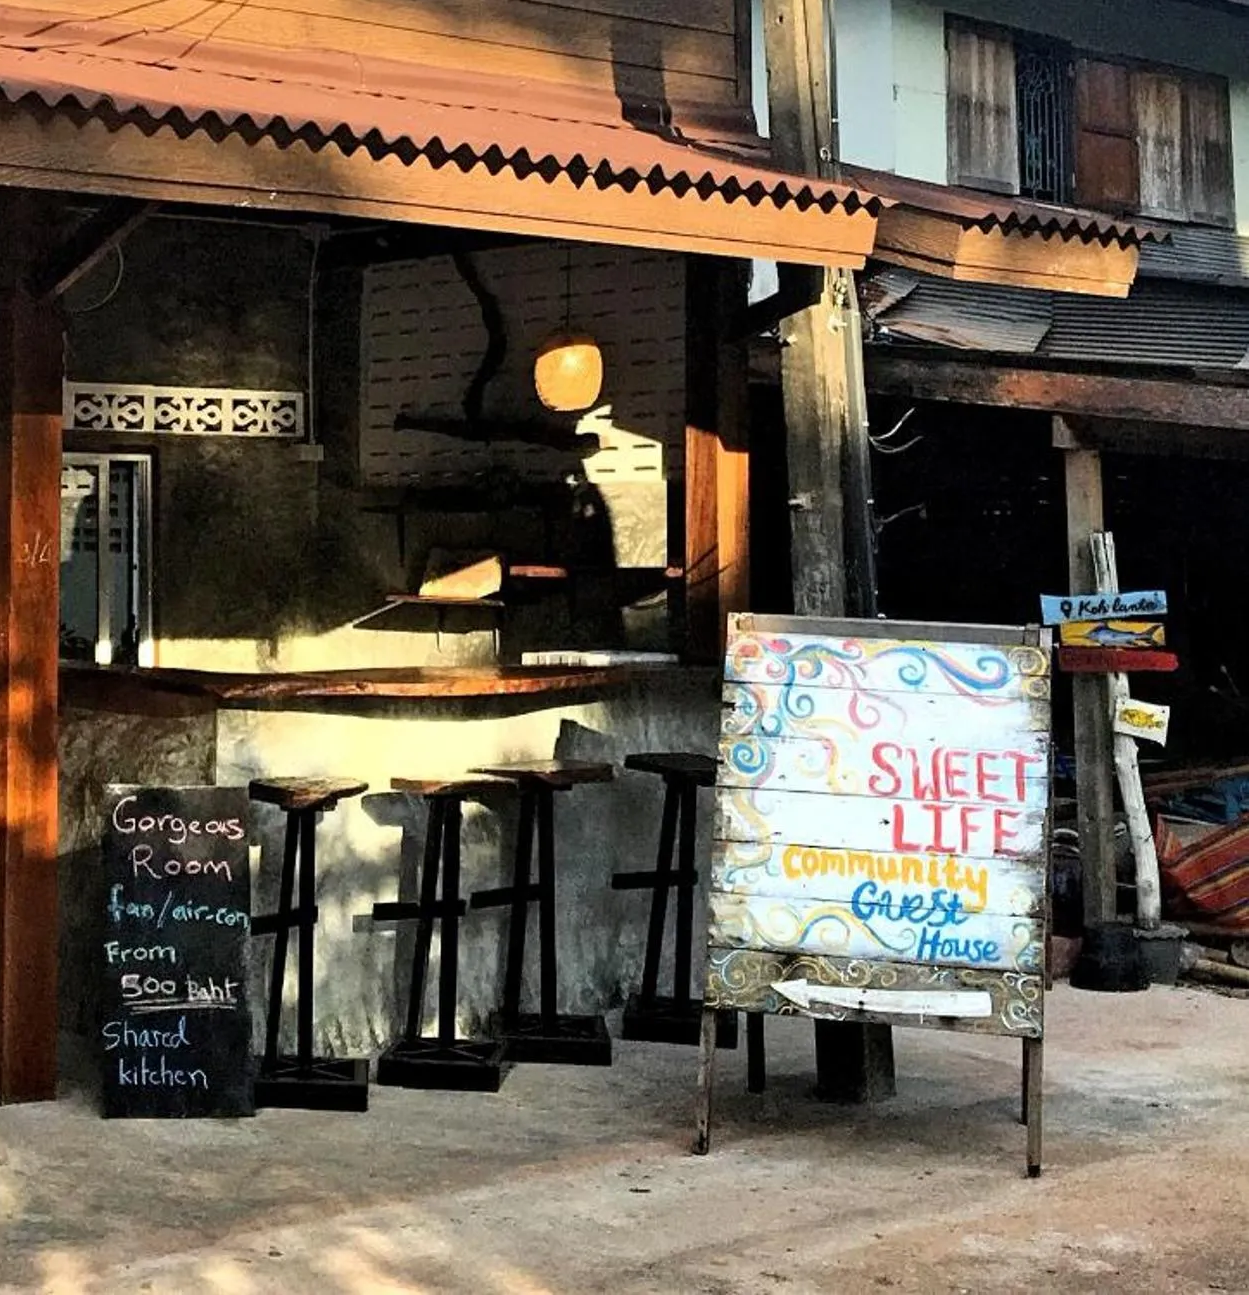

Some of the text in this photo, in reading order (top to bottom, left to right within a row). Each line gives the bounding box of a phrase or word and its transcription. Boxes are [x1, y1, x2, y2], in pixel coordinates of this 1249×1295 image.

[868, 741, 1042, 803] SWEET
[892, 803, 1024, 857] LIFE
[129, 845, 233, 882] Room
[104, 941, 176, 964] From
[916, 926, 1001, 963] House
[121, 974, 239, 1002] 500 Baht
[117, 1054, 209, 1091] kitchen
